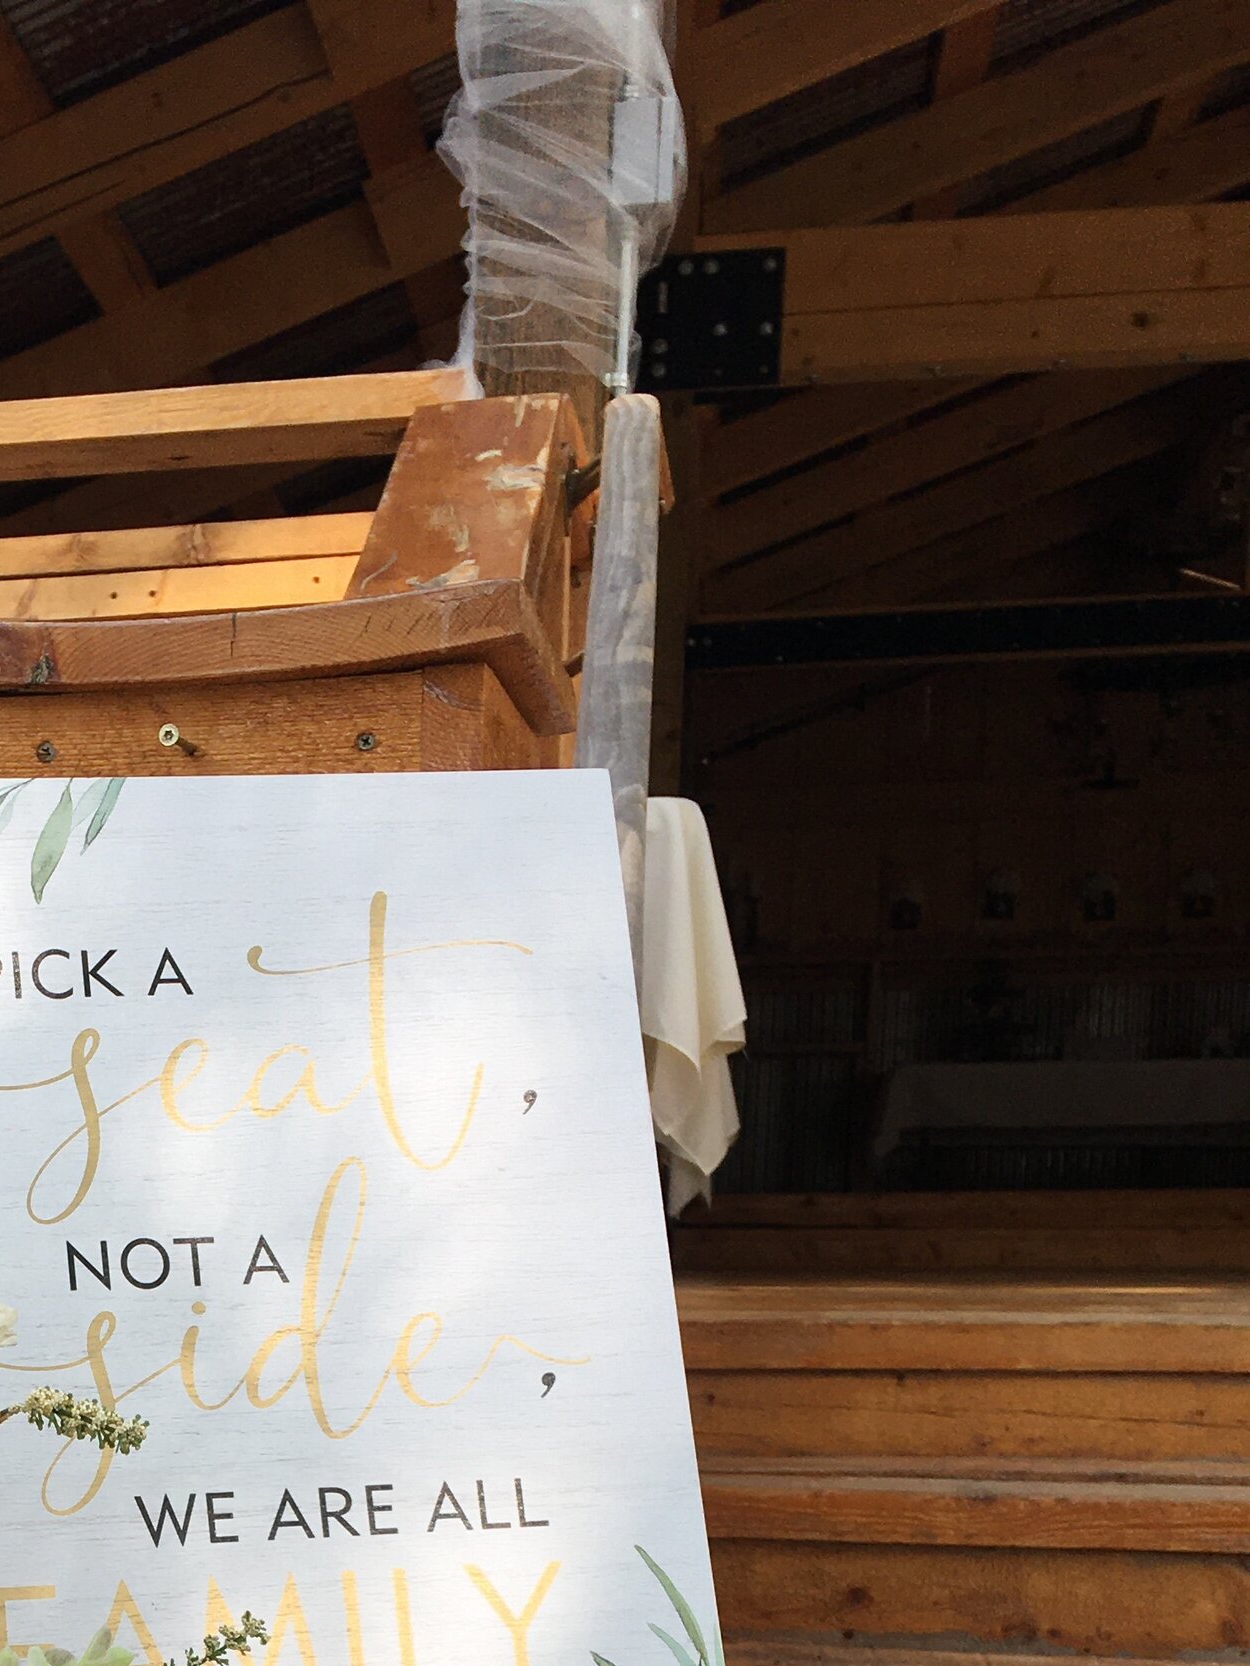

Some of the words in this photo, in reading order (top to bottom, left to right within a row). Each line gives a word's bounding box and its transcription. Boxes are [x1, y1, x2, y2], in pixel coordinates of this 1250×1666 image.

[147, 947, 195, 997] A
[65, 1236, 215, 1292] NOT
[242, 1233, 291, 1285] A
[133, 1490, 240, 1549] WE
[267, 1482, 399, 1542] ARE
[426, 1477, 550, 1533] ALL
